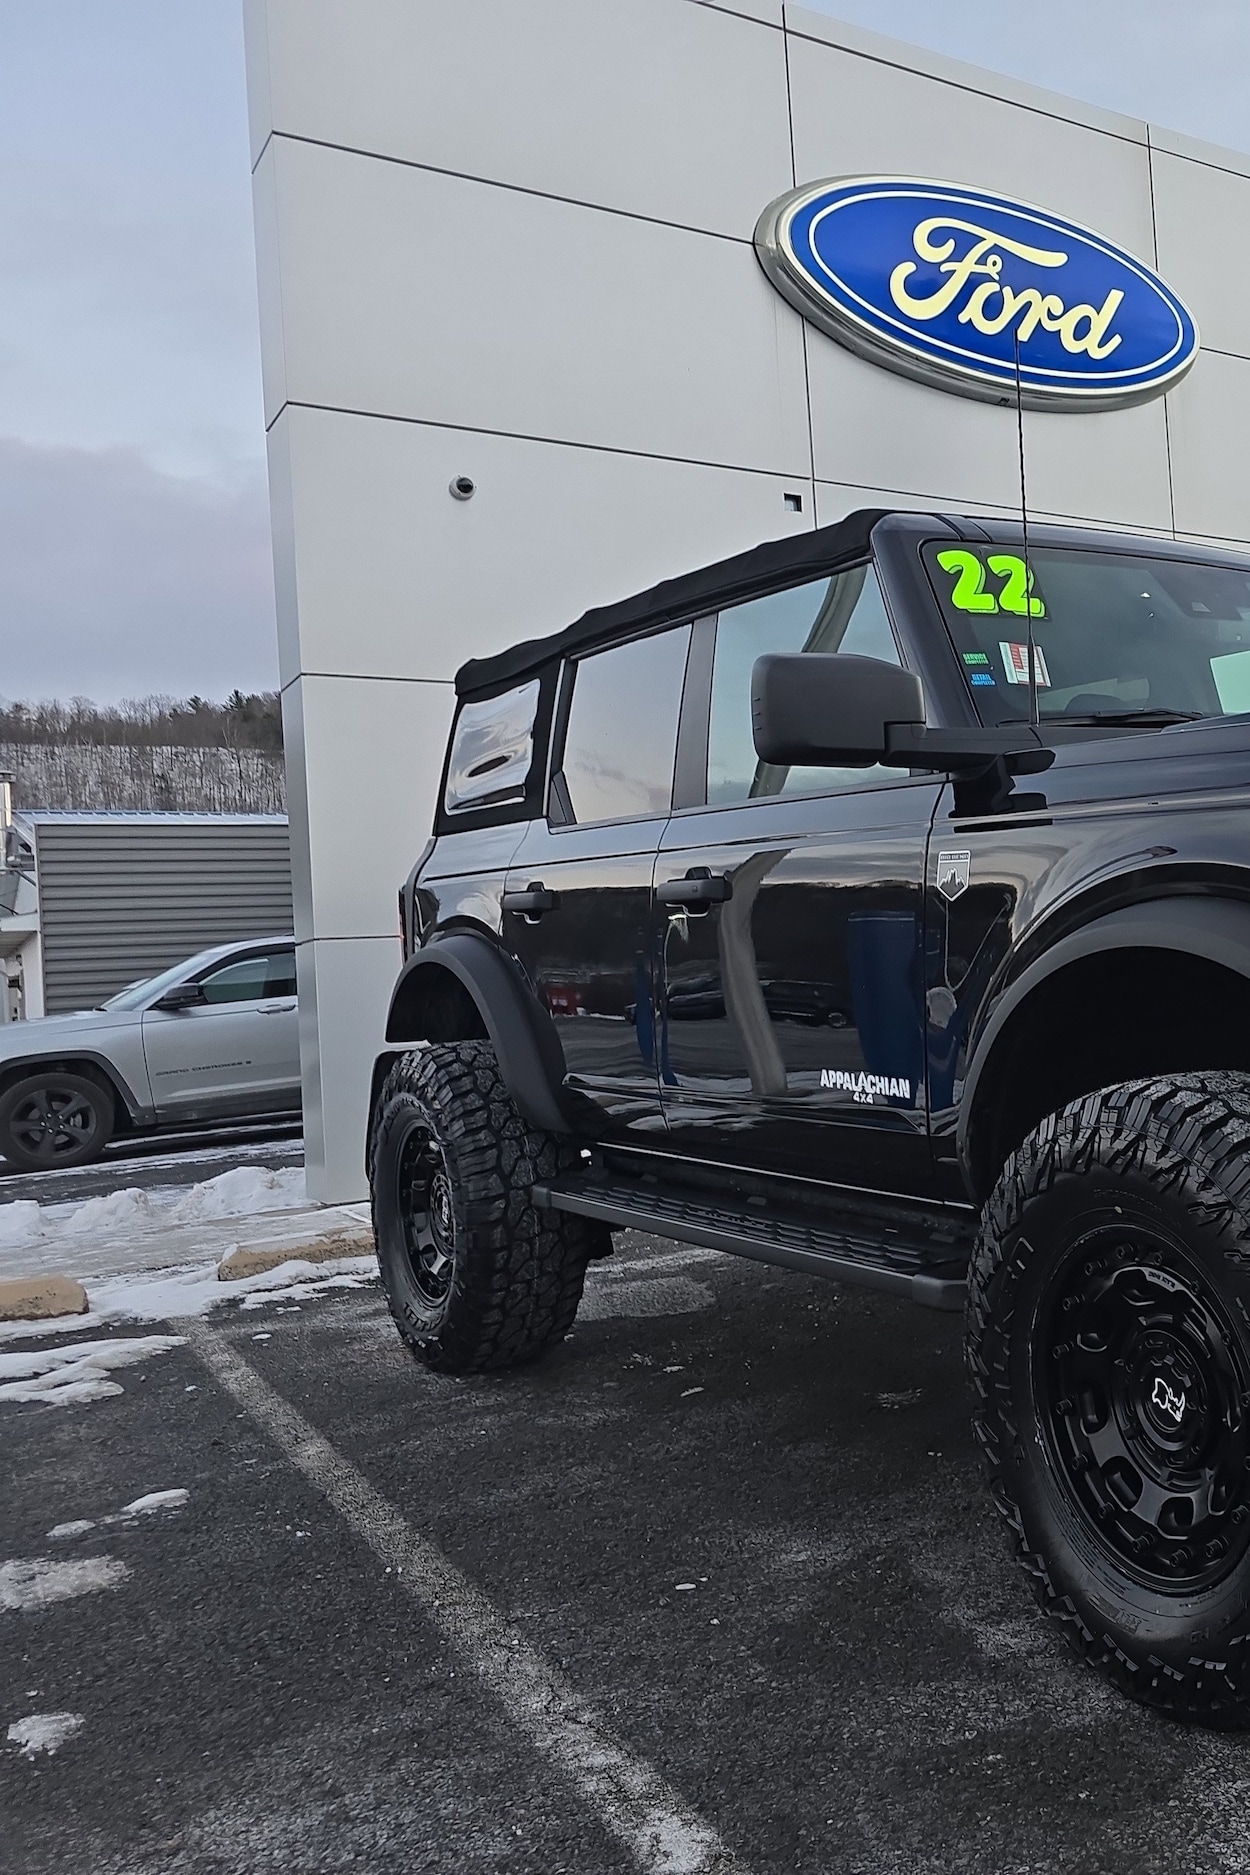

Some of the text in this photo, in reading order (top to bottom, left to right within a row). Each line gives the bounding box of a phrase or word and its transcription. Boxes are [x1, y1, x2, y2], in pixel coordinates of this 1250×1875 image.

[889, 217, 1125, 360] Ford
[937, 549, 1046, 618] 22
[820, 1068, 911, 1100] APPALACHIAN
